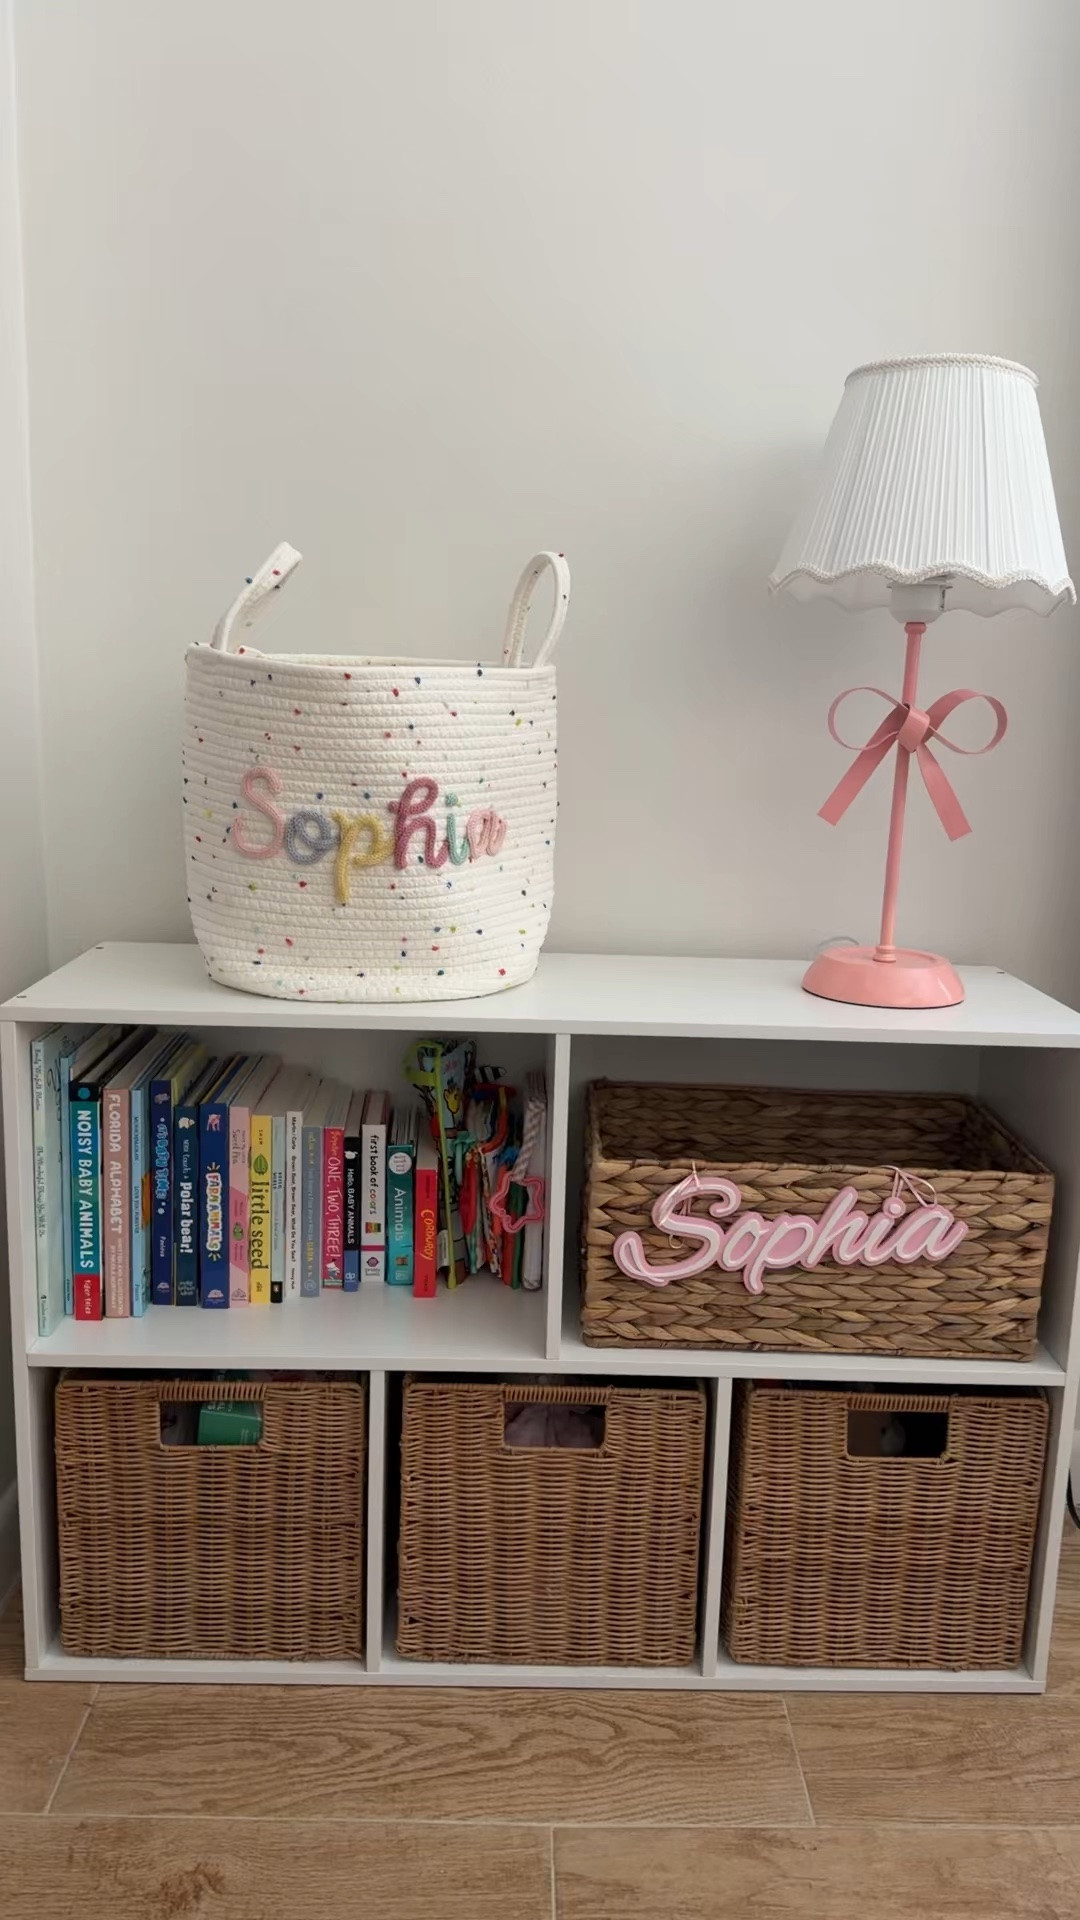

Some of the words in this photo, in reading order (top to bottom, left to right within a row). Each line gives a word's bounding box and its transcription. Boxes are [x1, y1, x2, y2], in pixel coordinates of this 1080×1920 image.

[231, 766, 509, 905] Sophia
[77, 1110, 93, 1155] NOISY
[108, 1094, 121, 1152] FLORIDA
[370, 1135, 379, 1154] first
[78, 1159, 93, 1195] BABY
[370, 1156, 379, 1176] book
[370, 1178, 379, 1188] of
[110, 1160, 123, 1234] ALPHABET
[180, 1182, 194, 1216] polar
[250, 1181, 270, 1225] little
[369, 1189, 379, 1215] colors
[394, 1188, 407, 1242] Animals
[79, 1199, 95, 1269] ANIMALS
[180, 1219, 194, 1253] bear!
[206, 1203, 223, 1251] ANIMALS
[326, 1215, 342, 1257] THREE!
[347, 1210, 355, 1244] ANIMALS
[419, 1209, 435, 1260] CORDUROY
[613, 1177, 969, 1295] Sophia
[251, 1230, 269, 1269] seed
